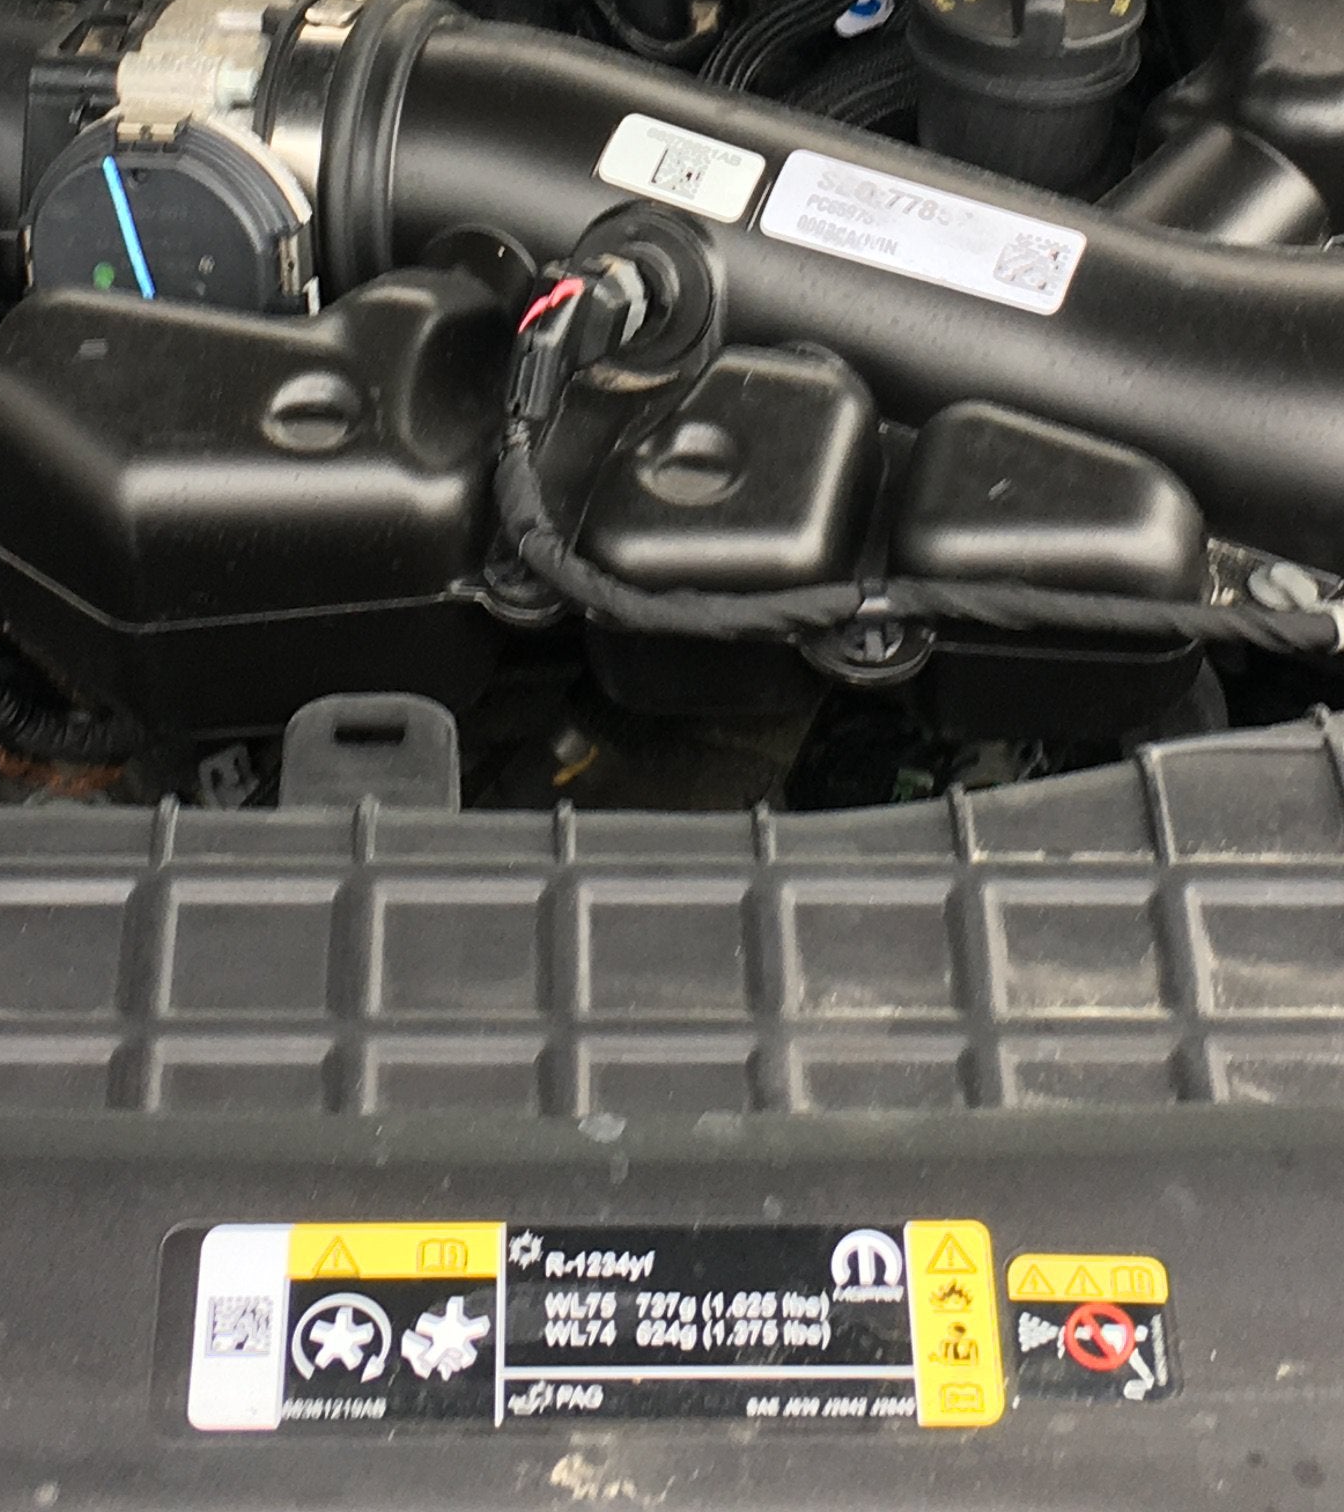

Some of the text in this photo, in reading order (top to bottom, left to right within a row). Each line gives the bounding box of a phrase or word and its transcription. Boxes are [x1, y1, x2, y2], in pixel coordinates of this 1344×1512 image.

[545, 1291, 616, 1319] WL75
[636, 1291, 696, 1323] 737g
[545, 1319, 616, 1347] WL74
[636, 1319, 697, 1351] 624g
